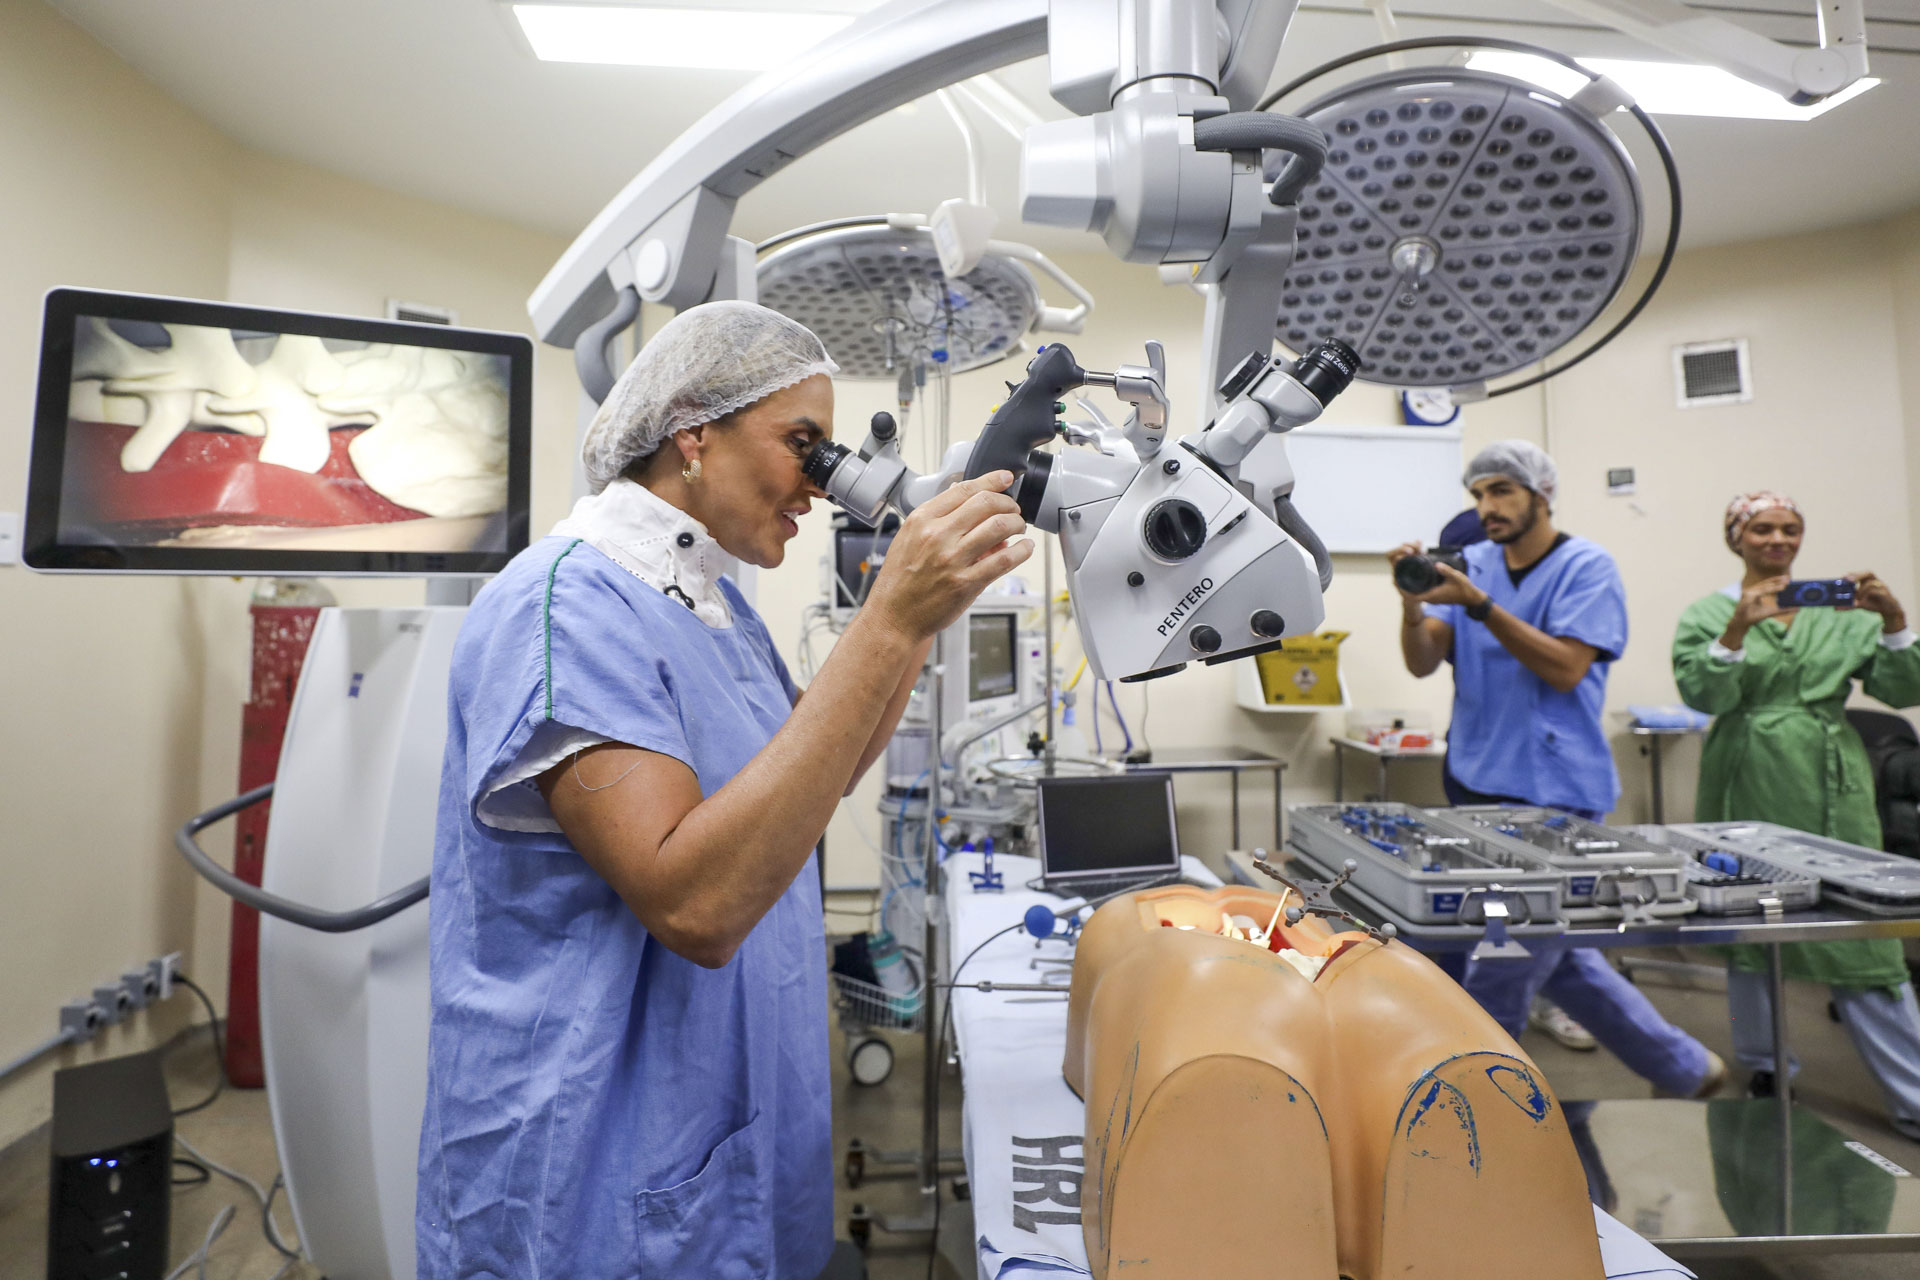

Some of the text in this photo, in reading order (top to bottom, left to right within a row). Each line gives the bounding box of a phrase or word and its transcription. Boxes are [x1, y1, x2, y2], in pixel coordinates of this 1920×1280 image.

[1320, 350, 1349, 375] Carl Zeiss
[1157, 577, 1214, 637] PENTERO
